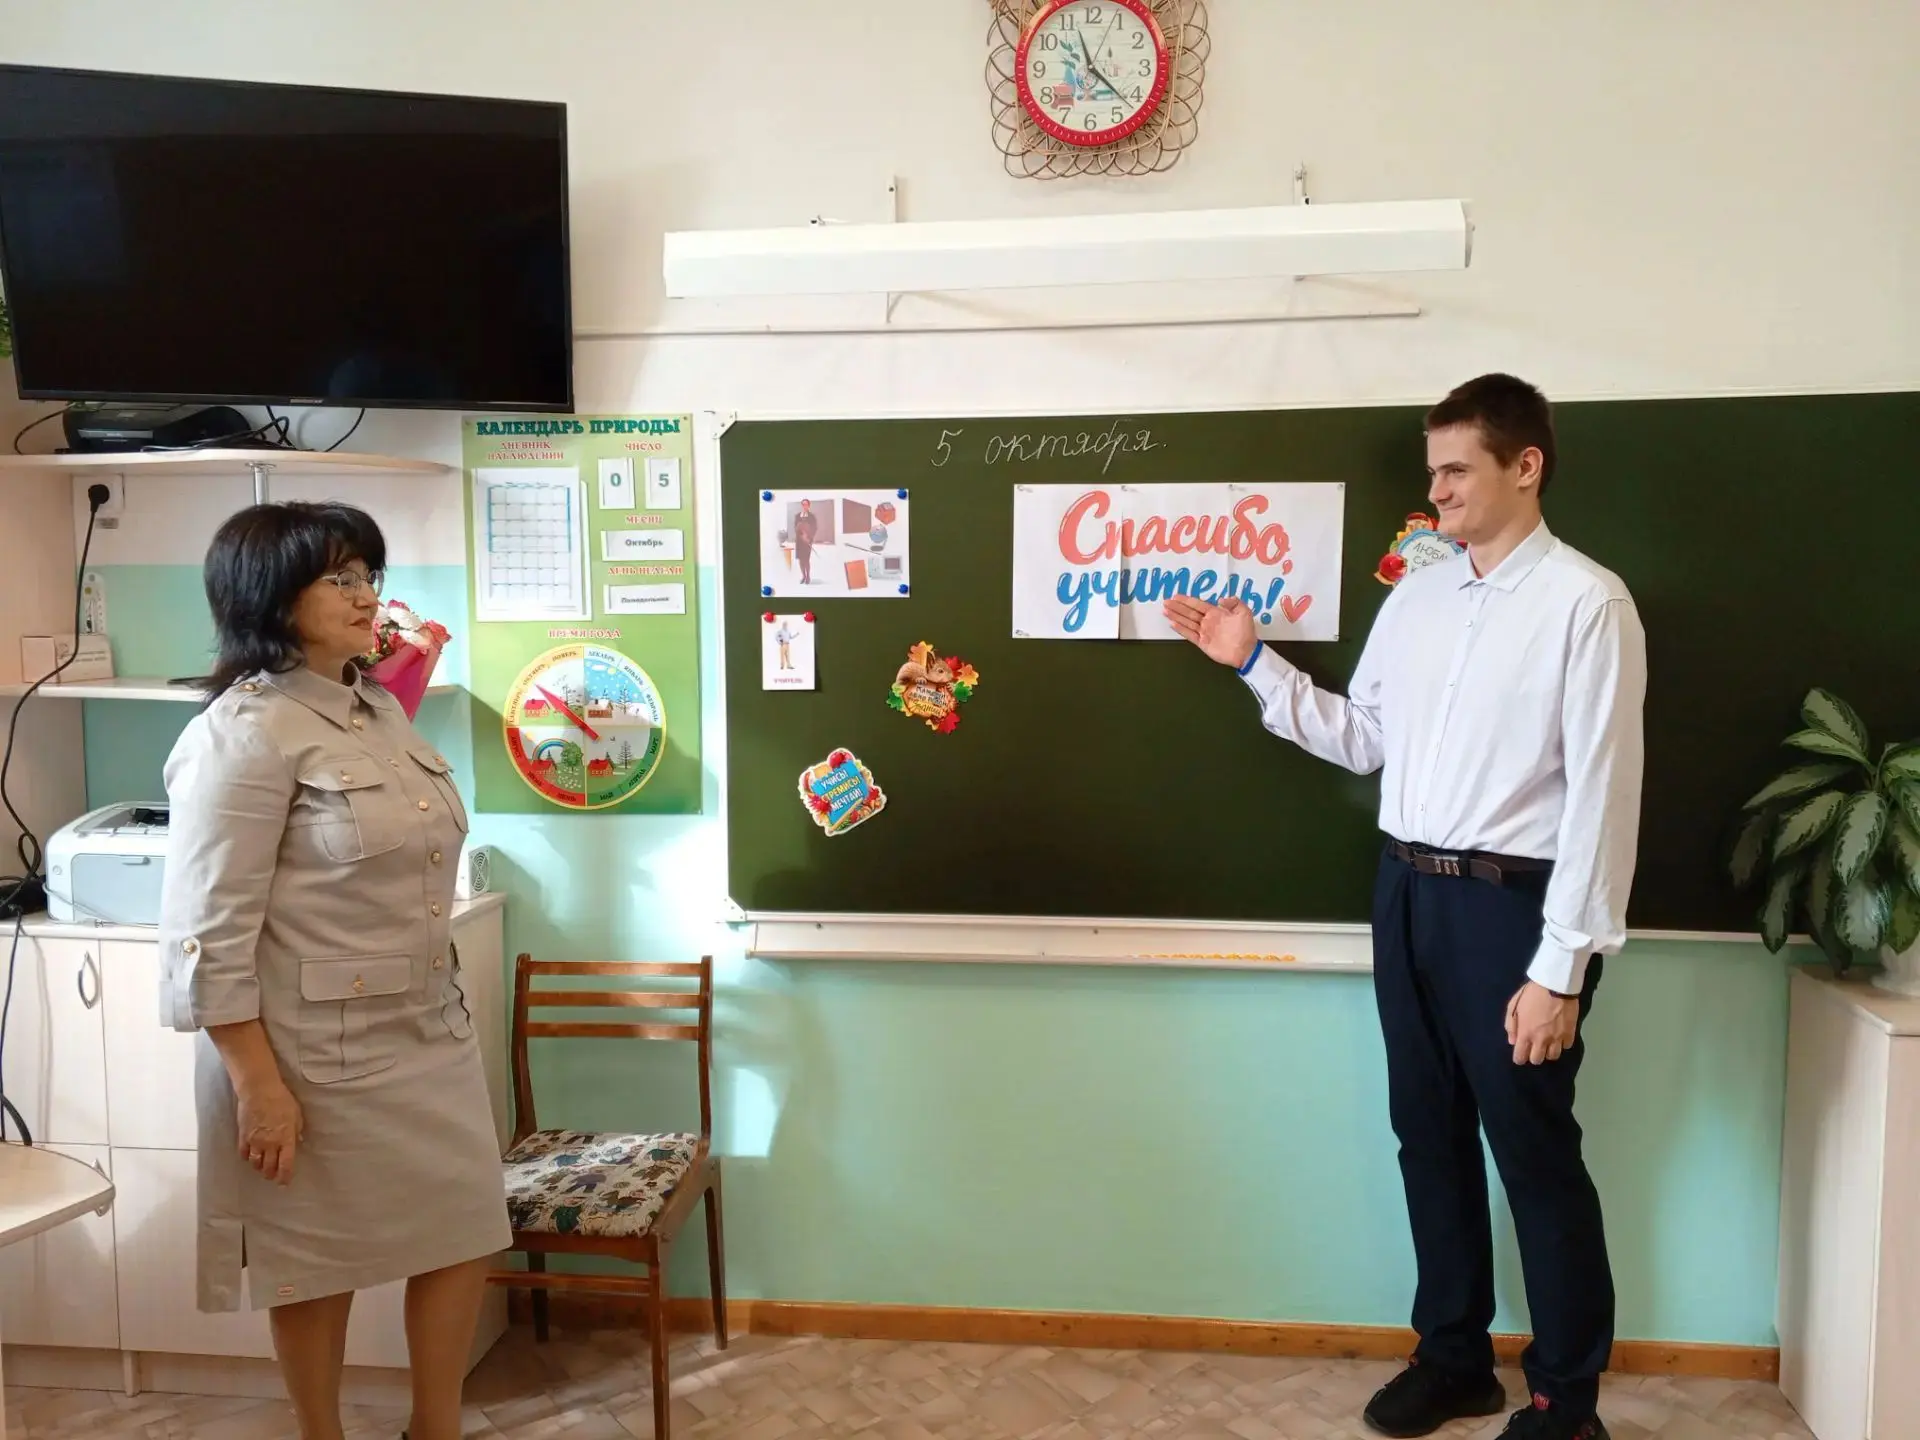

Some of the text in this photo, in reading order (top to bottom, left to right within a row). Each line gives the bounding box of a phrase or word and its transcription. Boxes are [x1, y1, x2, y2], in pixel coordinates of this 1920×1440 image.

[1059, 14, 1075, 31] 11
[1084, 6, 1103, 24] 12
[1115, 13, 1124, 31] 1
[1038, 33, 1058, 51] 10
[1131, 32, 1145, 50] 2
[1032, 61, 1046, 79] 9
[1138, 59, 1151, 77] 3
[1040, 87, 1053, 105] 8
[1130, 87, 1143, 103] 4
[1059, 107, 1071, 125] 7
[1084, 114, 1097, 131] 6
[1111, 106, 1124, 124] 5
[476, 419, 681, 437] КАЛЕНДАРЬ ПРИРОДЫ
[500, 440, 552, 450] ДНЕВНИК
[625, 442, 662, 451] ЧИСЛО
[931, 429, 963, 467] 5
[610, 473, 670, 487] 0 5
[1058, 490, 1293, 575] Спасибо,
[625, 538, 663, 547] Октябрь
[608, 567, 637, 575] ДЕНЬ
[549, 629, 621, 638] ВРЕМЯ ГОДА
[820, 769, 849, 790] УЧИСЬ!
